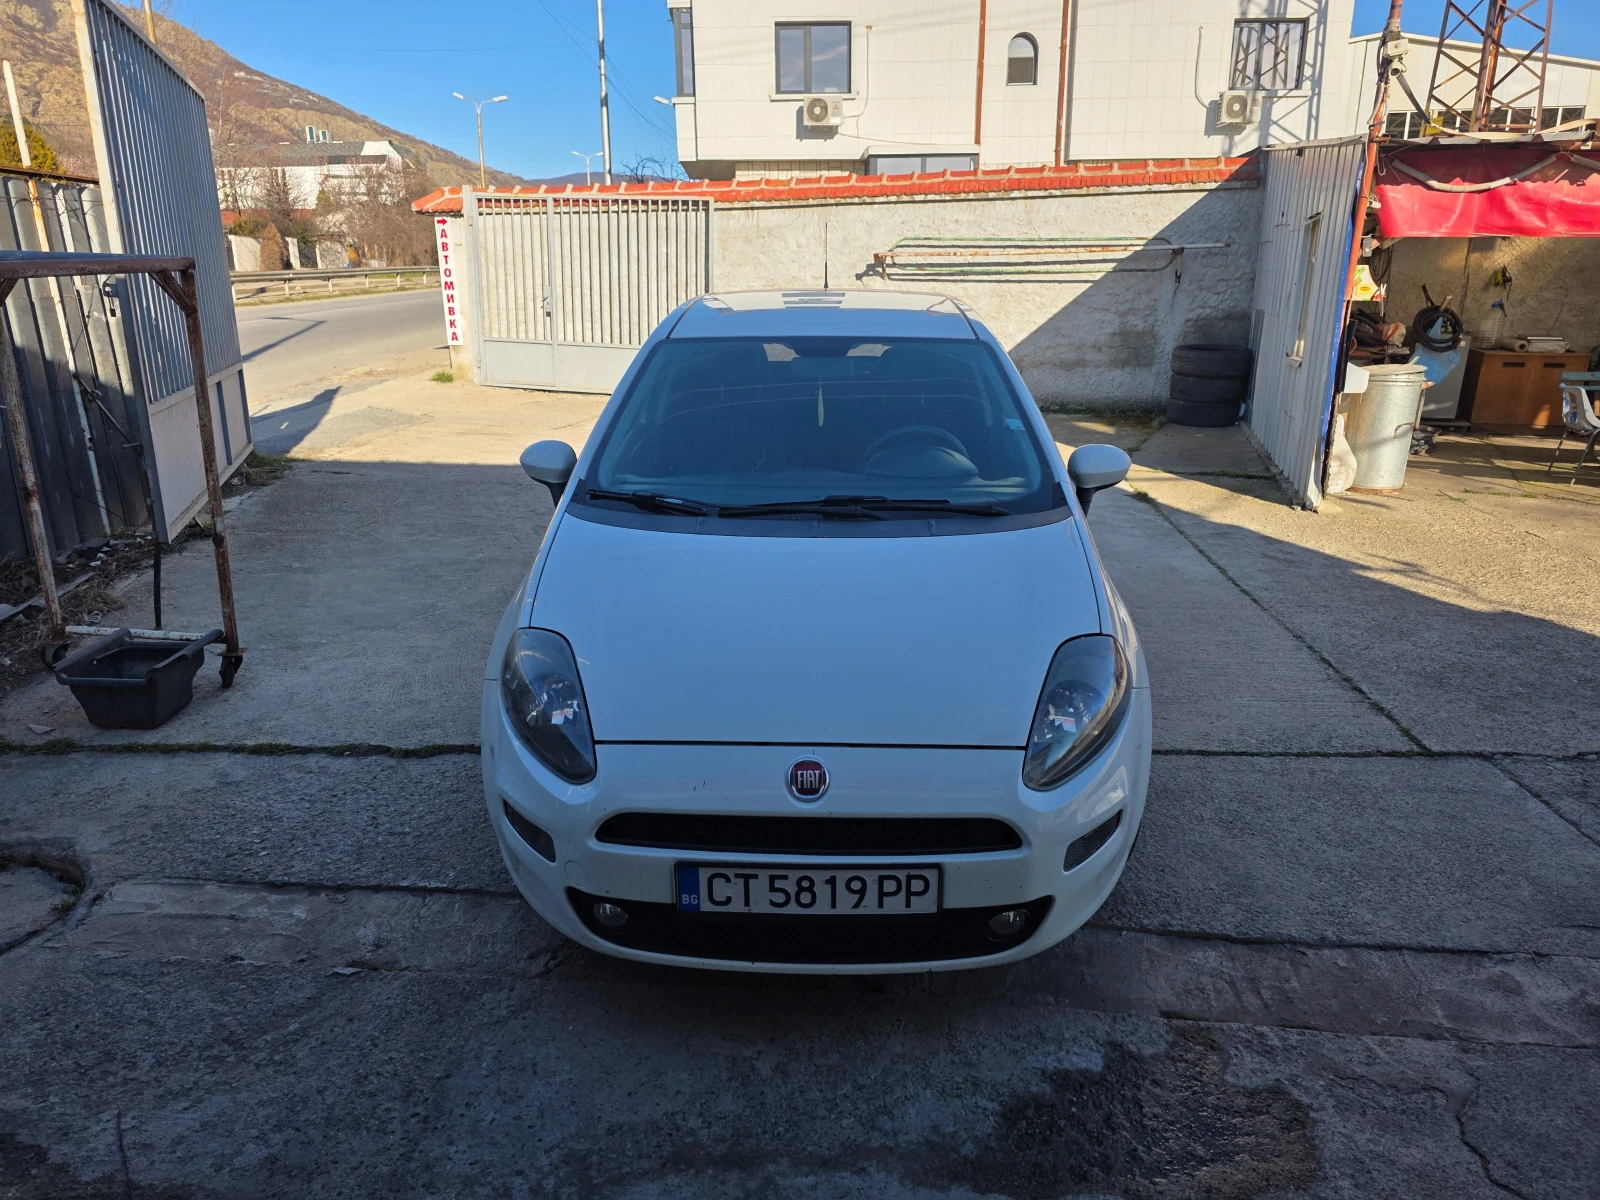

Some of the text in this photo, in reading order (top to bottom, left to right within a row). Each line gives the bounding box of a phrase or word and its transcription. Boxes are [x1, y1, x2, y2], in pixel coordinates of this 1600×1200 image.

[440, 228, 459, 341] АВТОМИВКА
[797, 770, 821, 789] FIAT
[682, 894, 698, 904] BG
[768, 874, 868, 909] 5819
